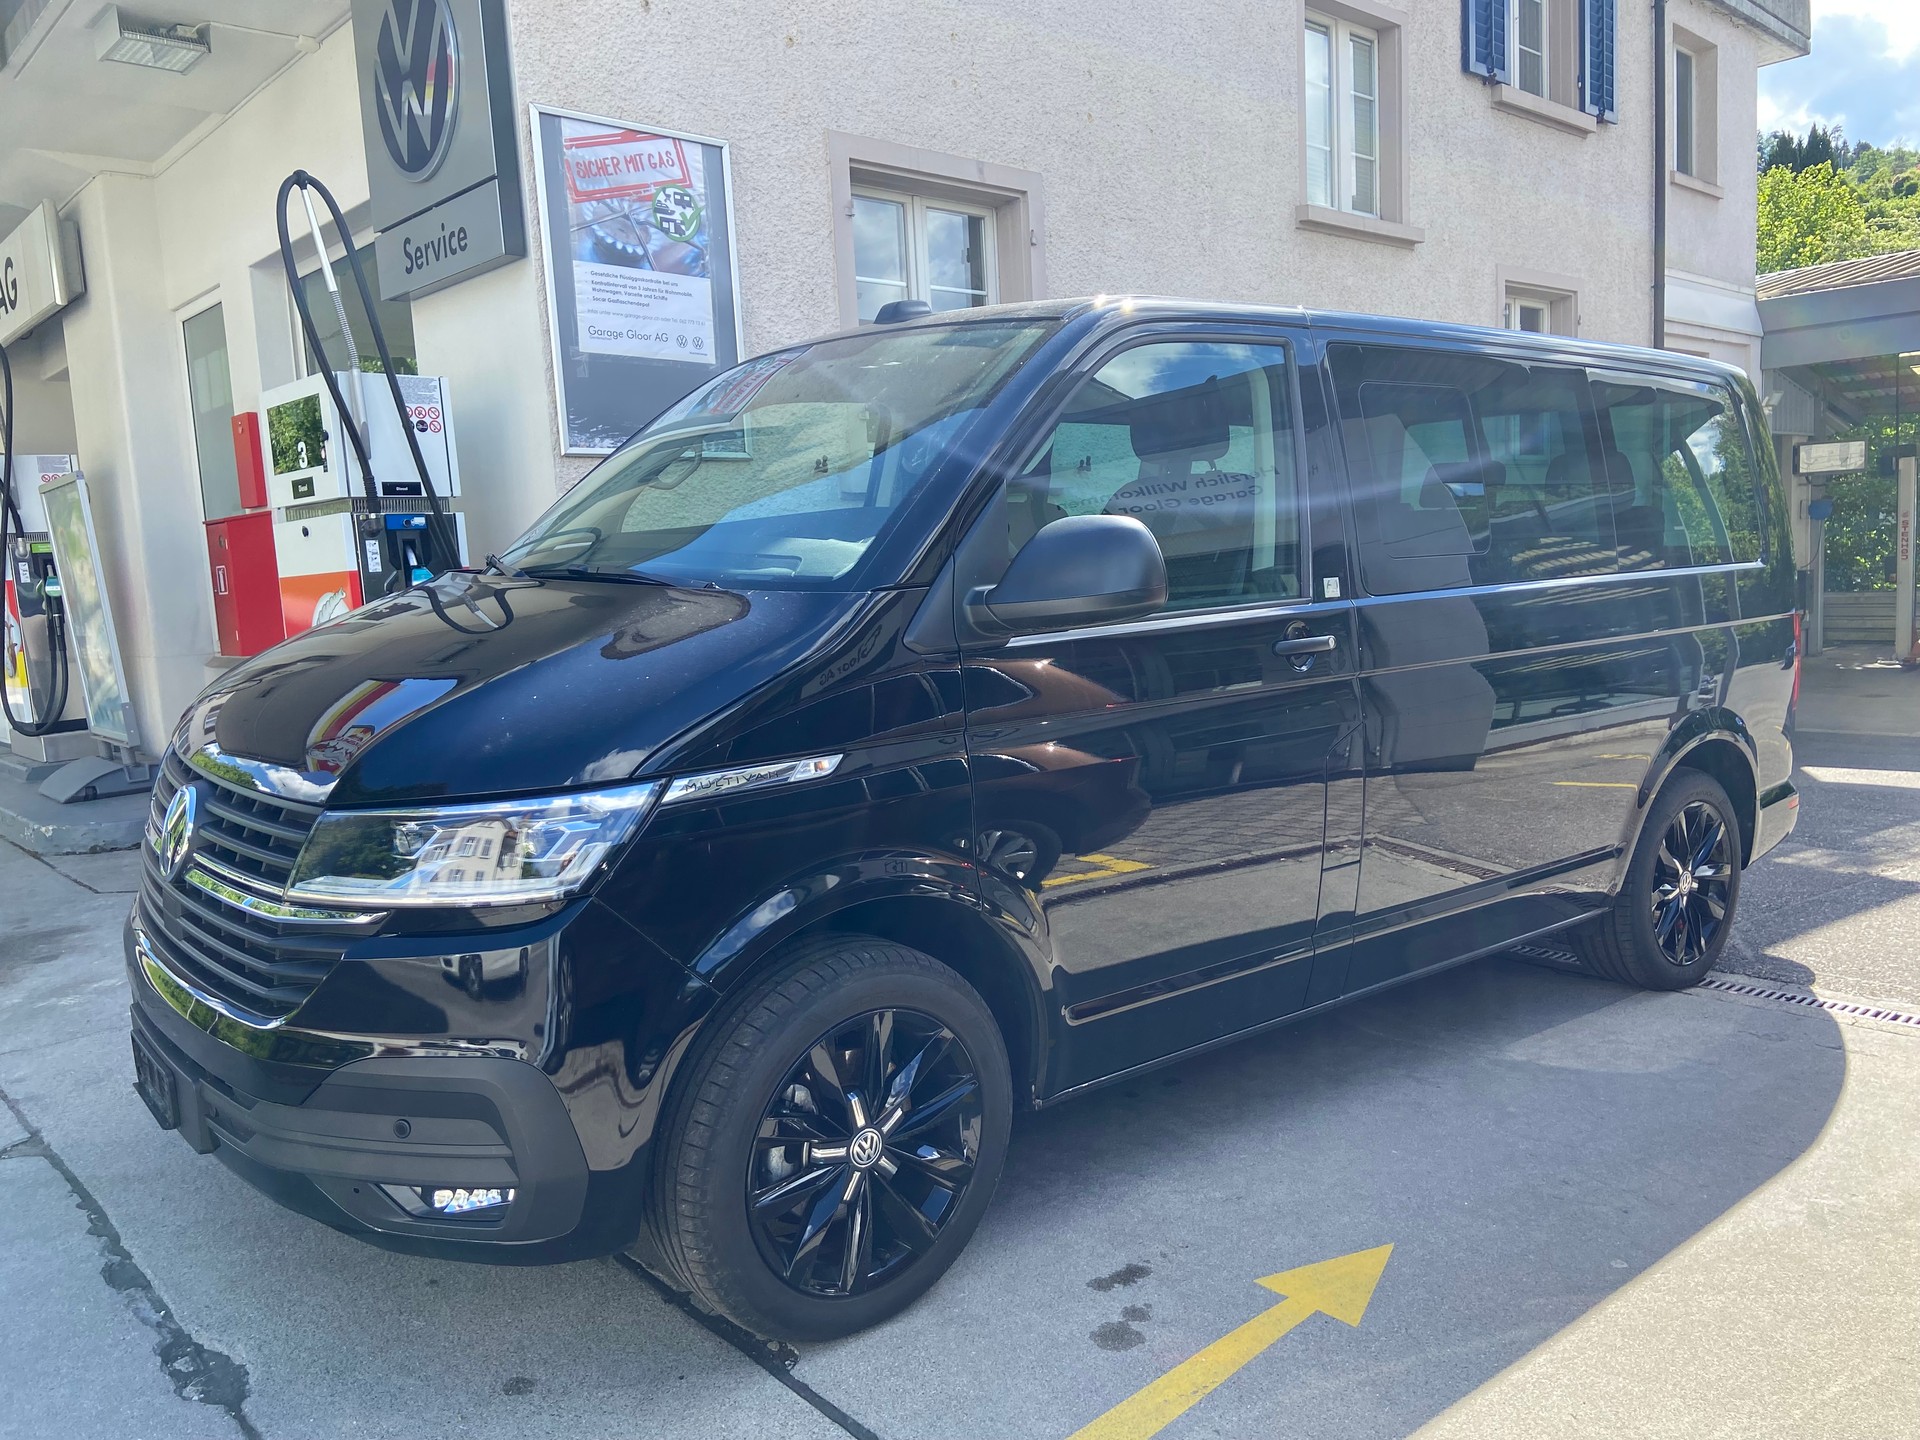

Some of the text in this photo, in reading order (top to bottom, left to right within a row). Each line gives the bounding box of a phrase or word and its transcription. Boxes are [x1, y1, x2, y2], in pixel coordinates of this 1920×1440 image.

[575, 150, 675, 178] SICHER MIT GAS
[403, 222, 468, 275] Service
[588, 325, 624, 340] Garage
[626, 329, 652, 341] Gloor
[654, 332, 669, 343] AG
[297, 441, 308, 469] 3
